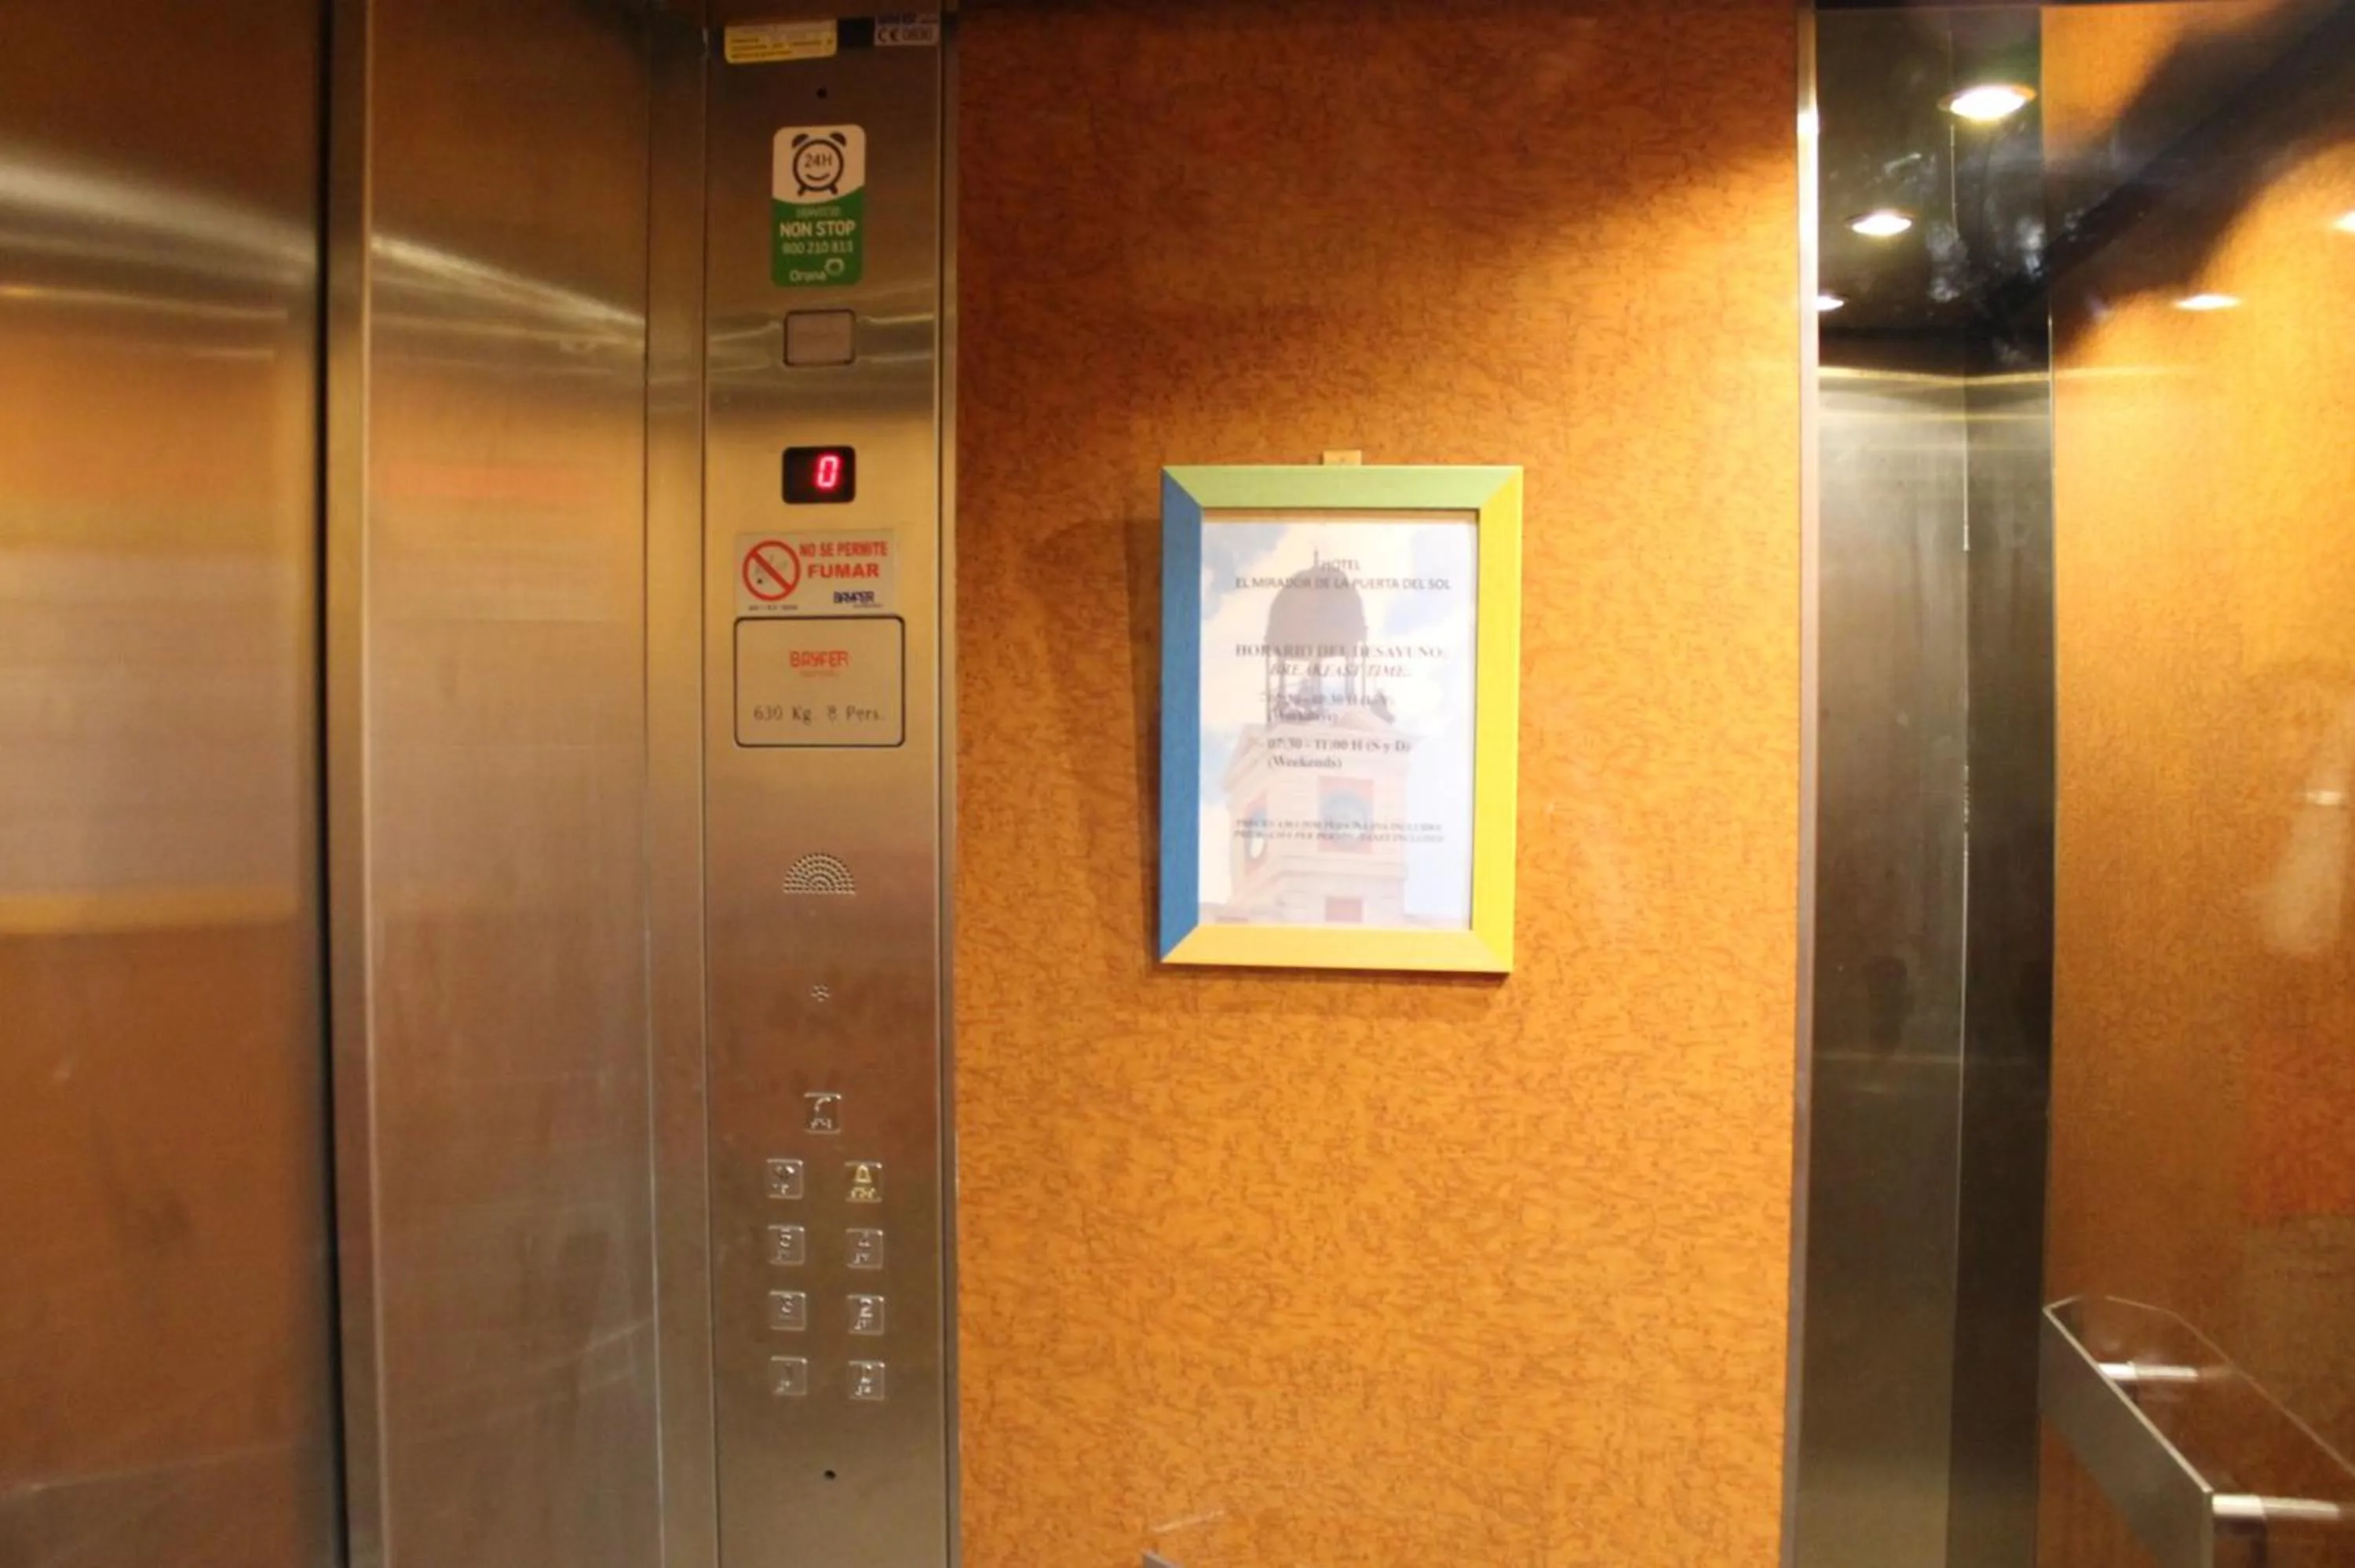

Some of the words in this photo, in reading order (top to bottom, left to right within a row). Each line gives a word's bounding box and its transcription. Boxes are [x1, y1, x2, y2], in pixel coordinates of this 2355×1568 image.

[805, 152, 833, 168] 24H
[780, 221, 812, 239] NON
[816, 220, 856, 237] STOP
[818, 456, 838, 487] 0
[799, 543, 816, 557] NO
[820, 542, 834, 557] SE
[837, 541, 888, 556] PERMITE
[808, 563, 880, 578] FUMAR
[1321, 558, 1361, 572] HOTEL
[1235, 577, 1248, 589] EL
[1251, 577, 1312, 589] MIRADOR
[1315, 577, 1331, 589] DE
[1334, 577, 1349, 589] LA
[1353, 578, 1400, 590] PUERTA
[1402, 578, 1425, 590] DEL
[1427, 578, 1451, 590] SOL
[1236, 644, 1313, 658] HORARIO
[1317, 644, 1347, 658] DEL
[790, 650, 849, 668] BAYFER
[1269, 663, 1360, 677] BREAKFAST
[754, 706, 783, 721] 630
[827, 705, 838, 720] 8
[1267, 755, 1343, 769] (Weekends)
